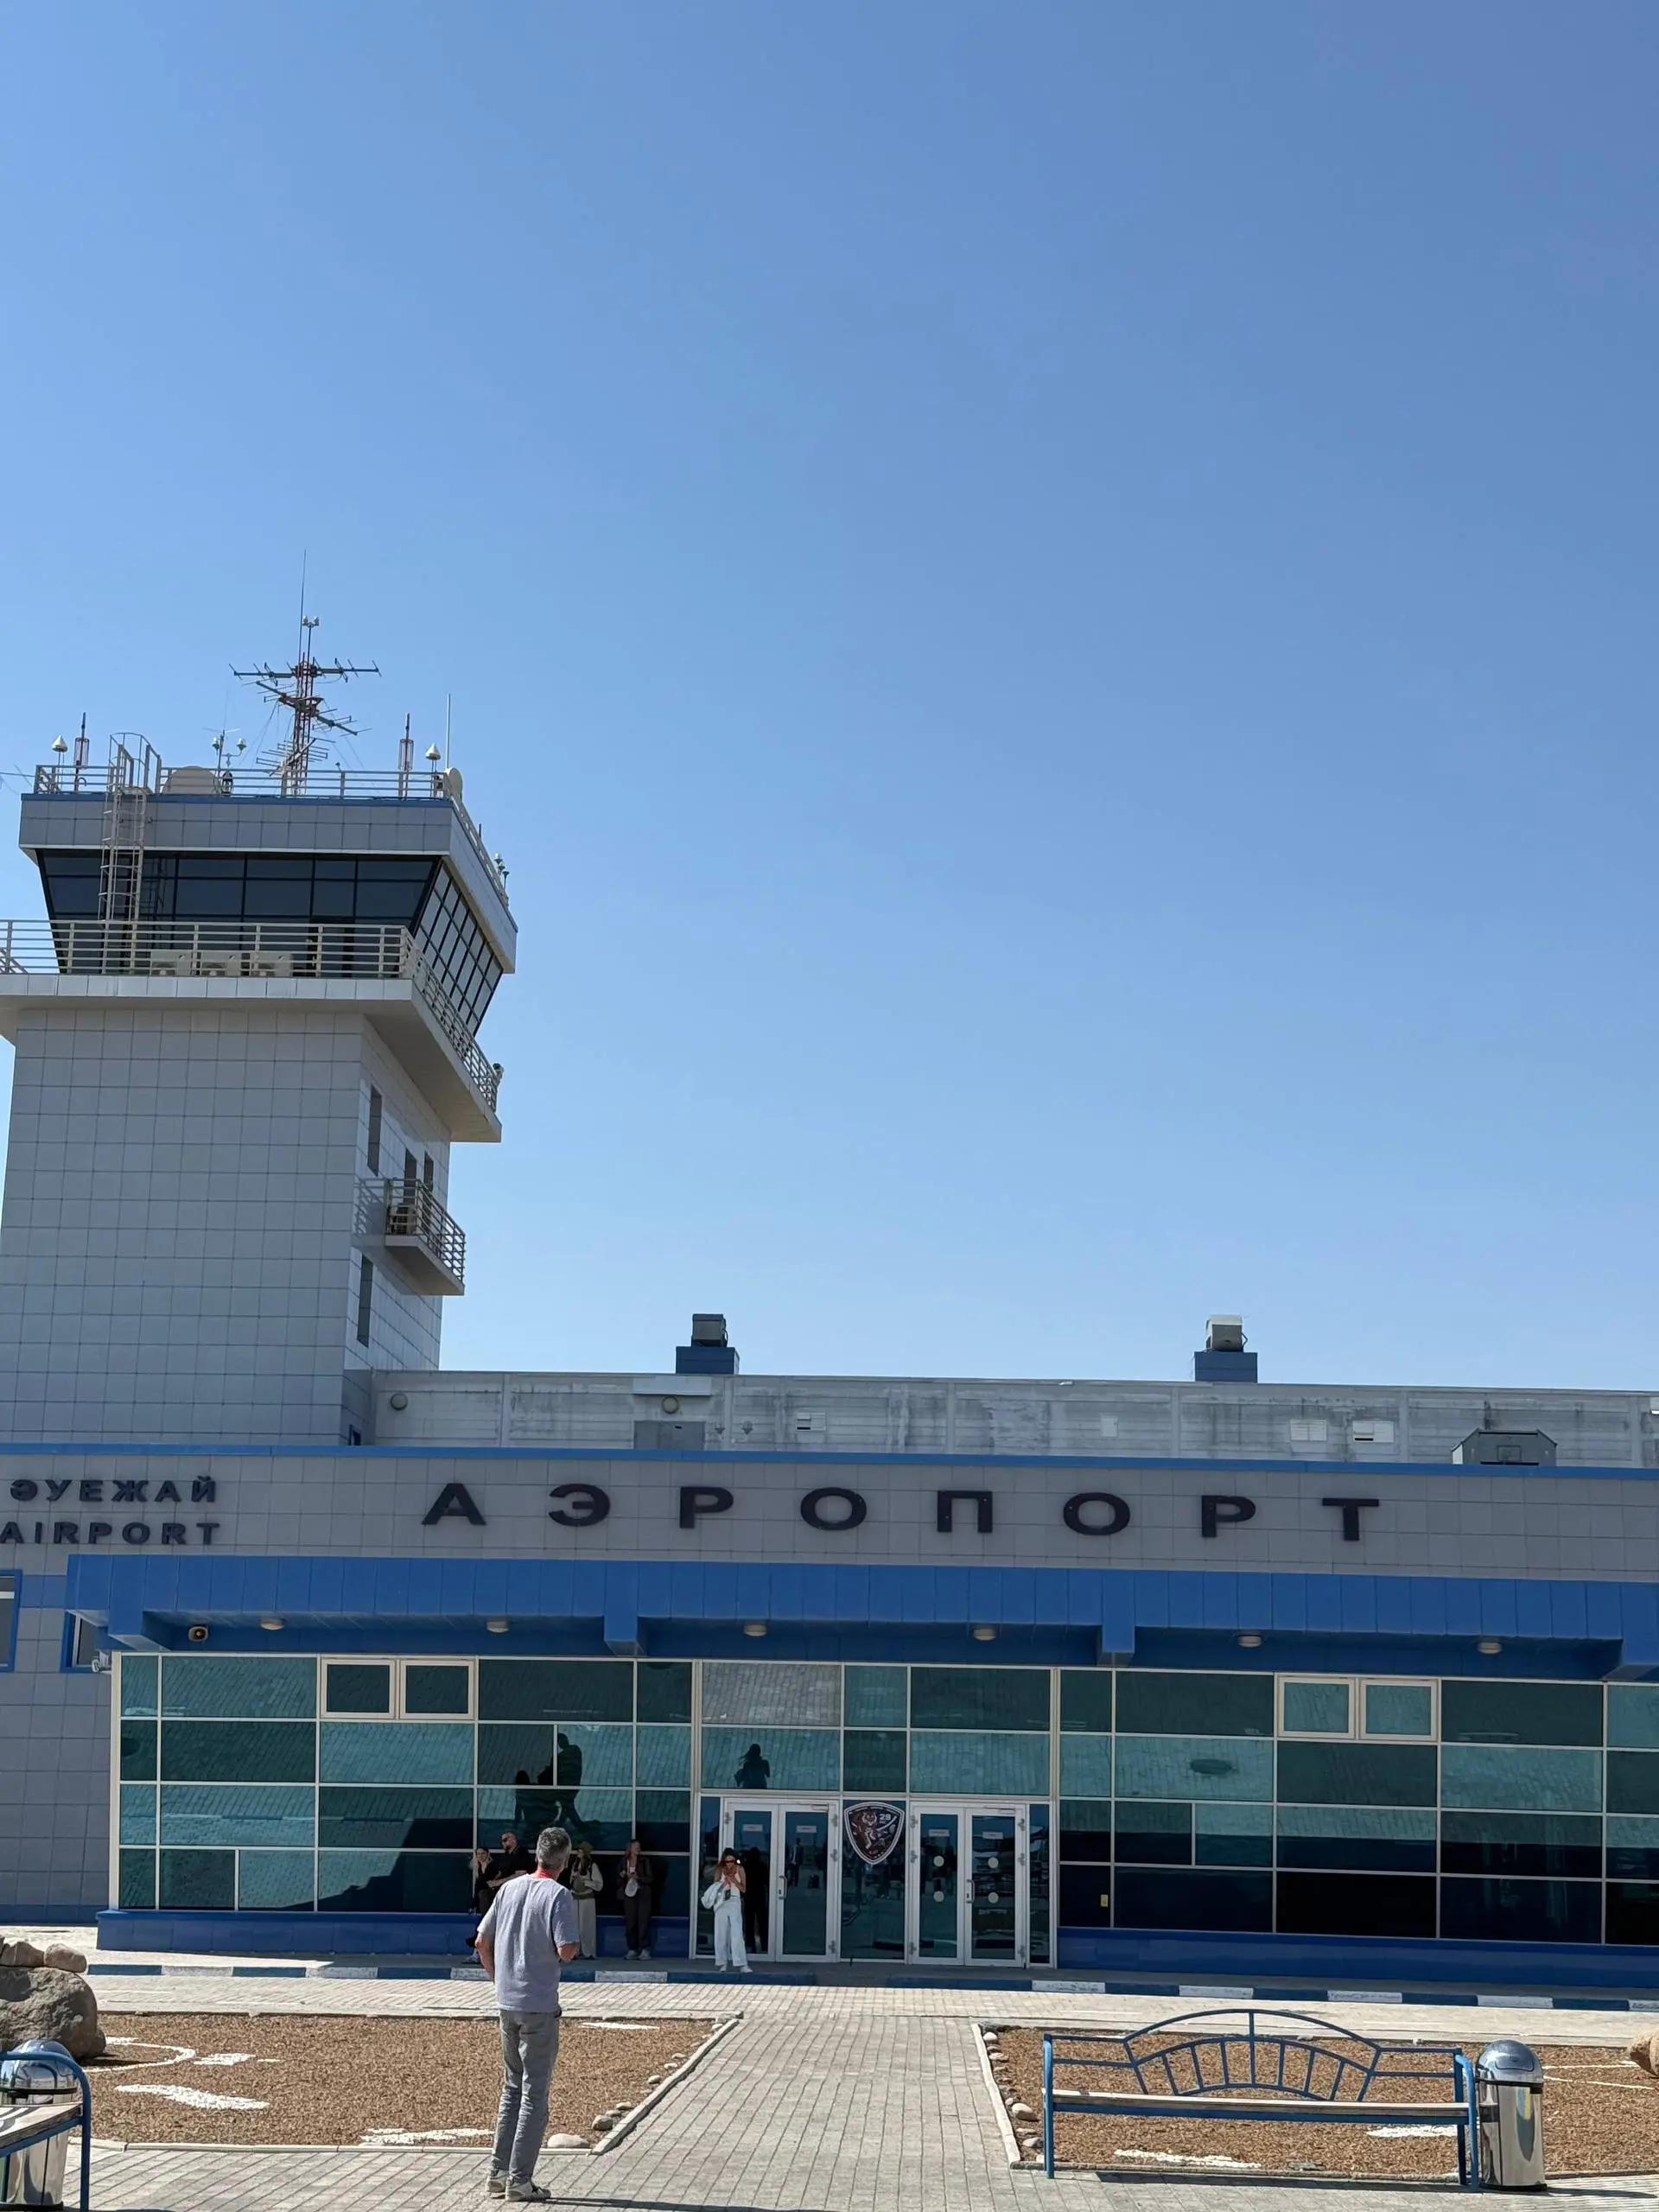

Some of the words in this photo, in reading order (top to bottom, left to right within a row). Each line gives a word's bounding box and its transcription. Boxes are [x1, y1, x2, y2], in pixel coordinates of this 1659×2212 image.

[10, 1475, 216, 1503] ӘУЕЖАЙ
[422, 1481, 1380, 1542] АЭРОПОРТ
[0, 1521, 220, 1546] AIRPORT
